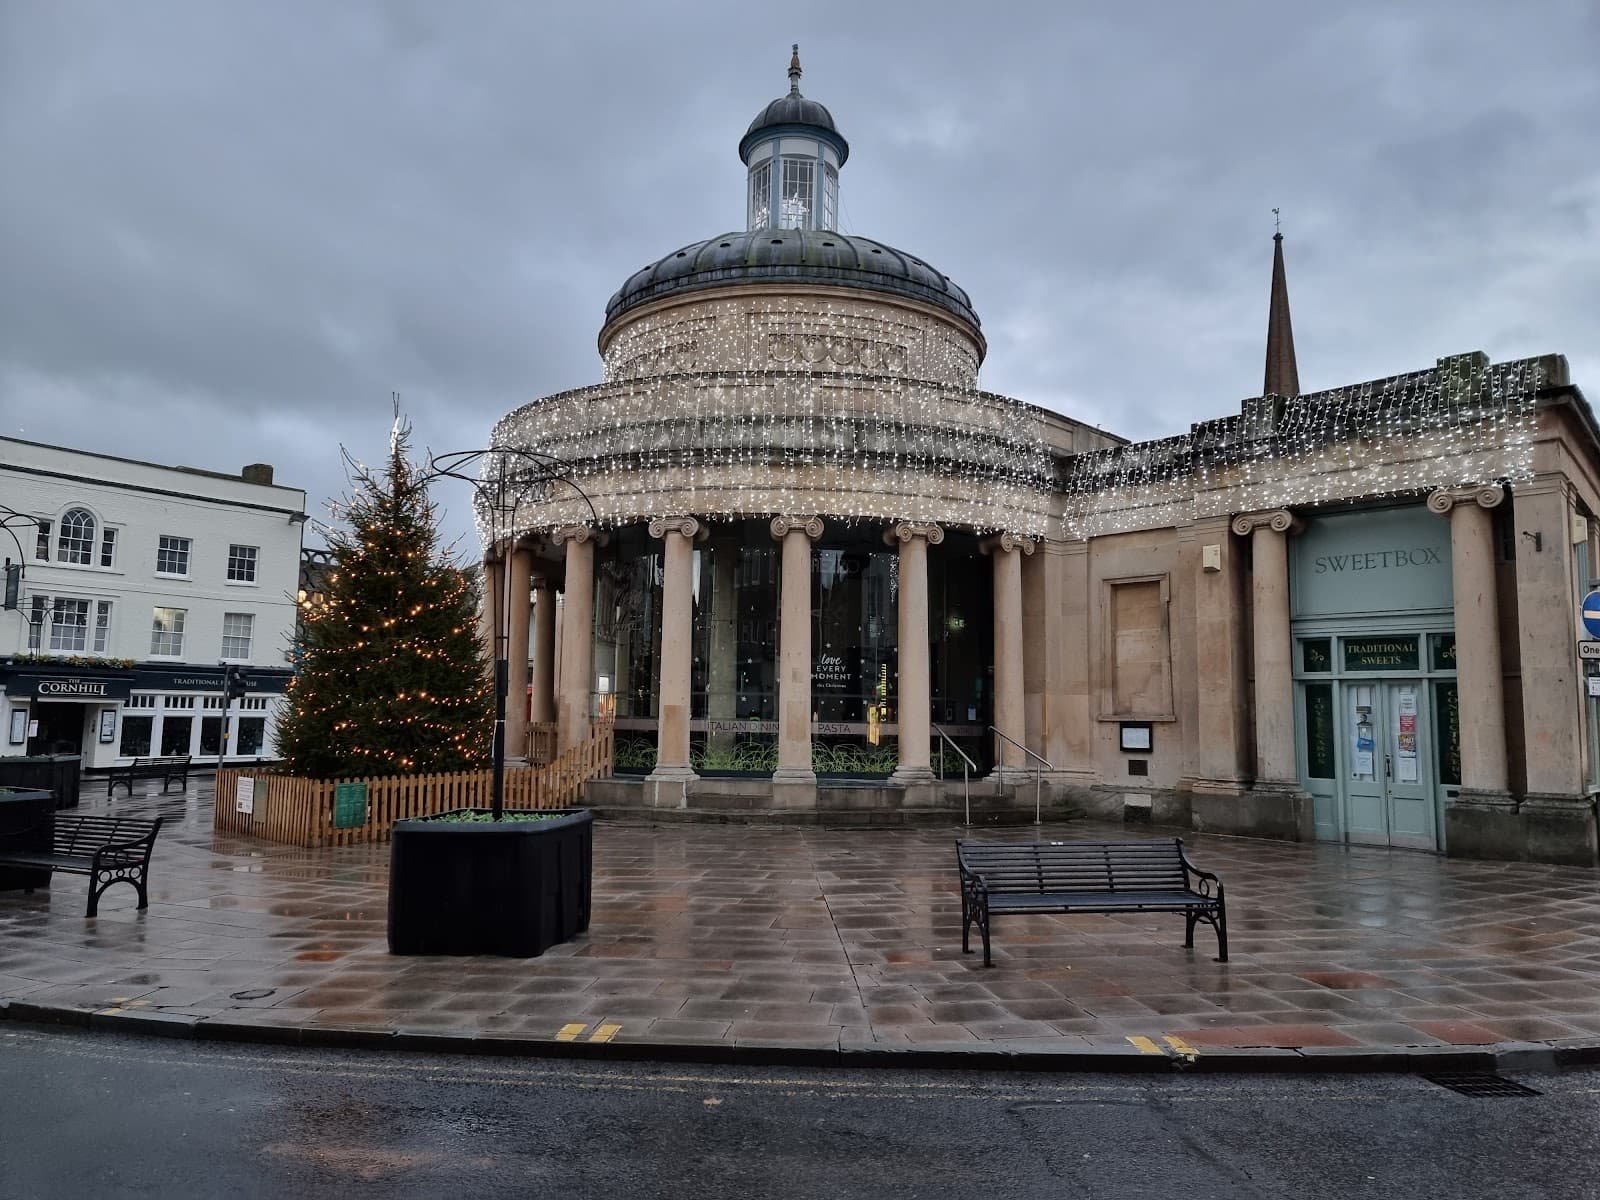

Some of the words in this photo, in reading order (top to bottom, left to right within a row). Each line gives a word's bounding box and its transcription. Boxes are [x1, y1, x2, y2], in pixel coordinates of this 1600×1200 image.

[1315, 548, 1441, 574] SWEETBOX
[1347, 643, 1416, 653] TRADITIONAL
[1583, 646, 1600, 654] One
[821, 653, 842, 665] love
[1361, 656, 1401, 665] SWEETS
[173, 678, 219, 686] TRADITIONAL
[38, 682, 108, 696] CORNHILL
[707, 721, 747, 732] ITALIAN
[750, 722, 779, 732] DININ
[818, 723, 851, 733] PASTA
